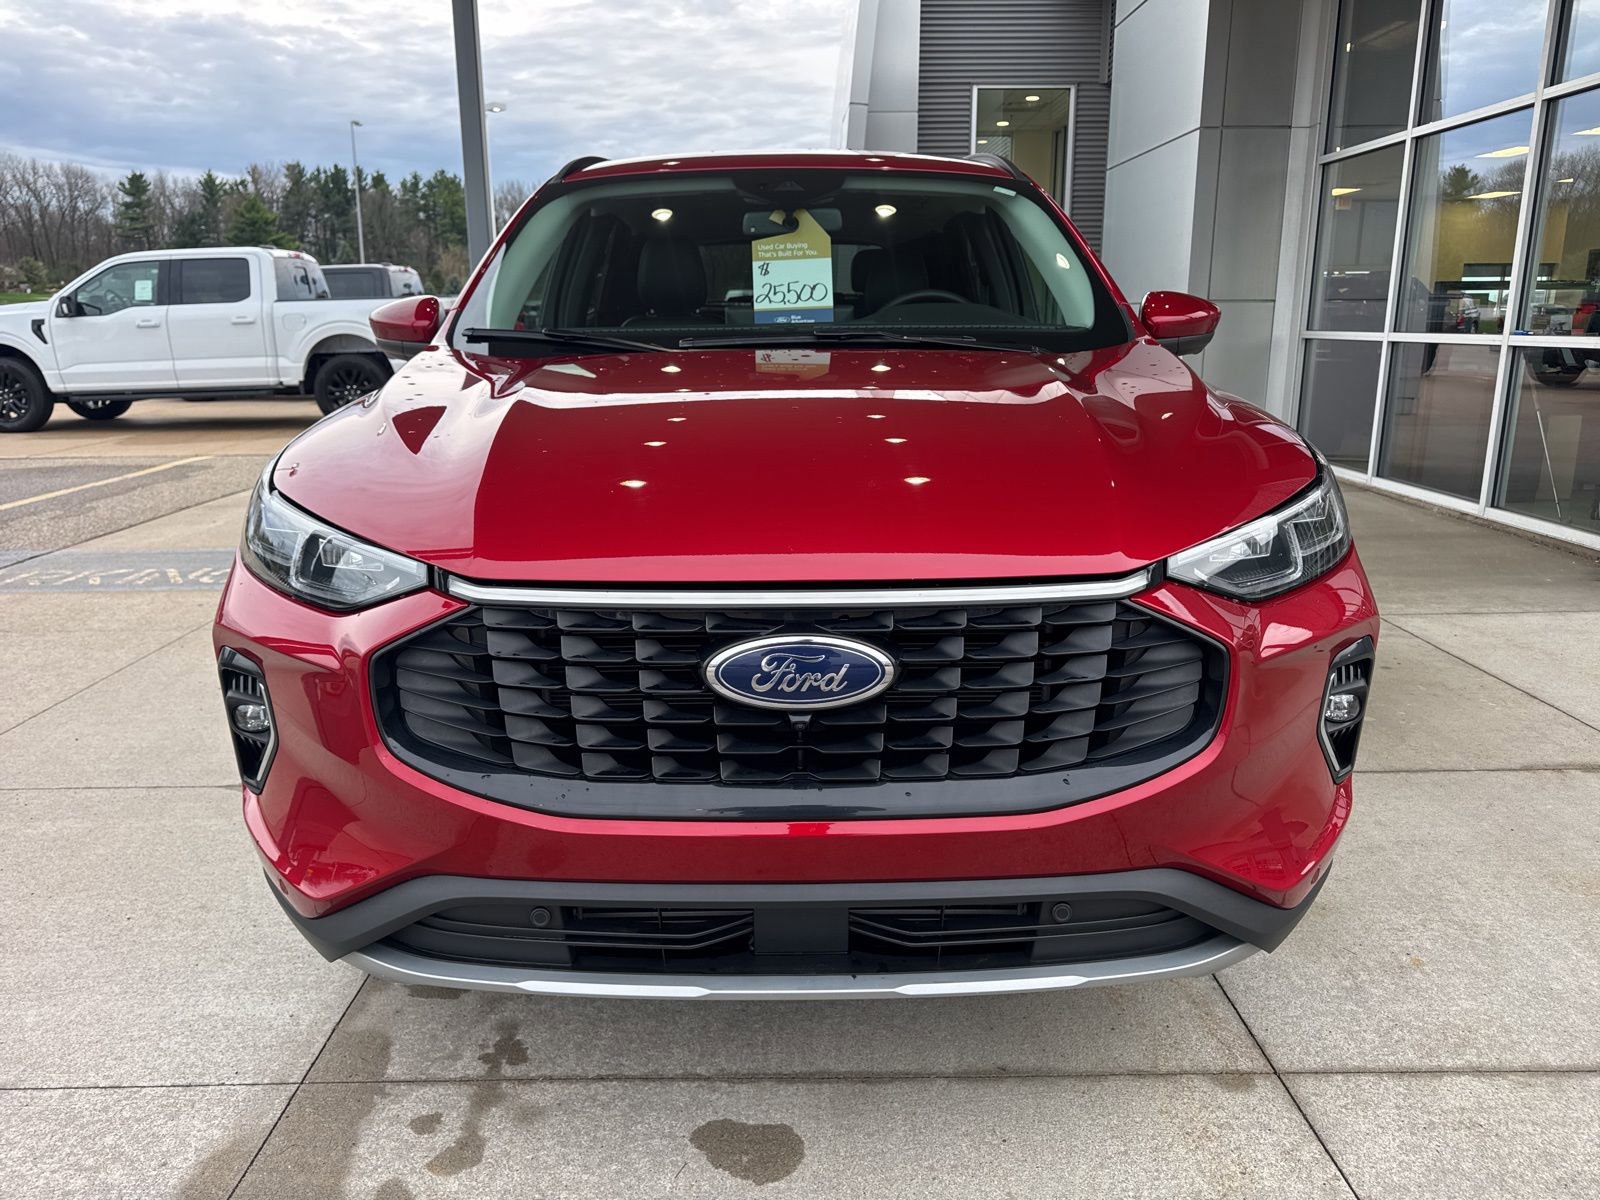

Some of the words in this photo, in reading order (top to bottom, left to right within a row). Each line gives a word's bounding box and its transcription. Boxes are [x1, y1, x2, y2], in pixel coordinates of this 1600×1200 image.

[757, 243, 774, 251] Used
[786, 242, 808, 251] Buying
[755, 281, 828, 305] 25,500
[751, 652, 850, 693] Ford
